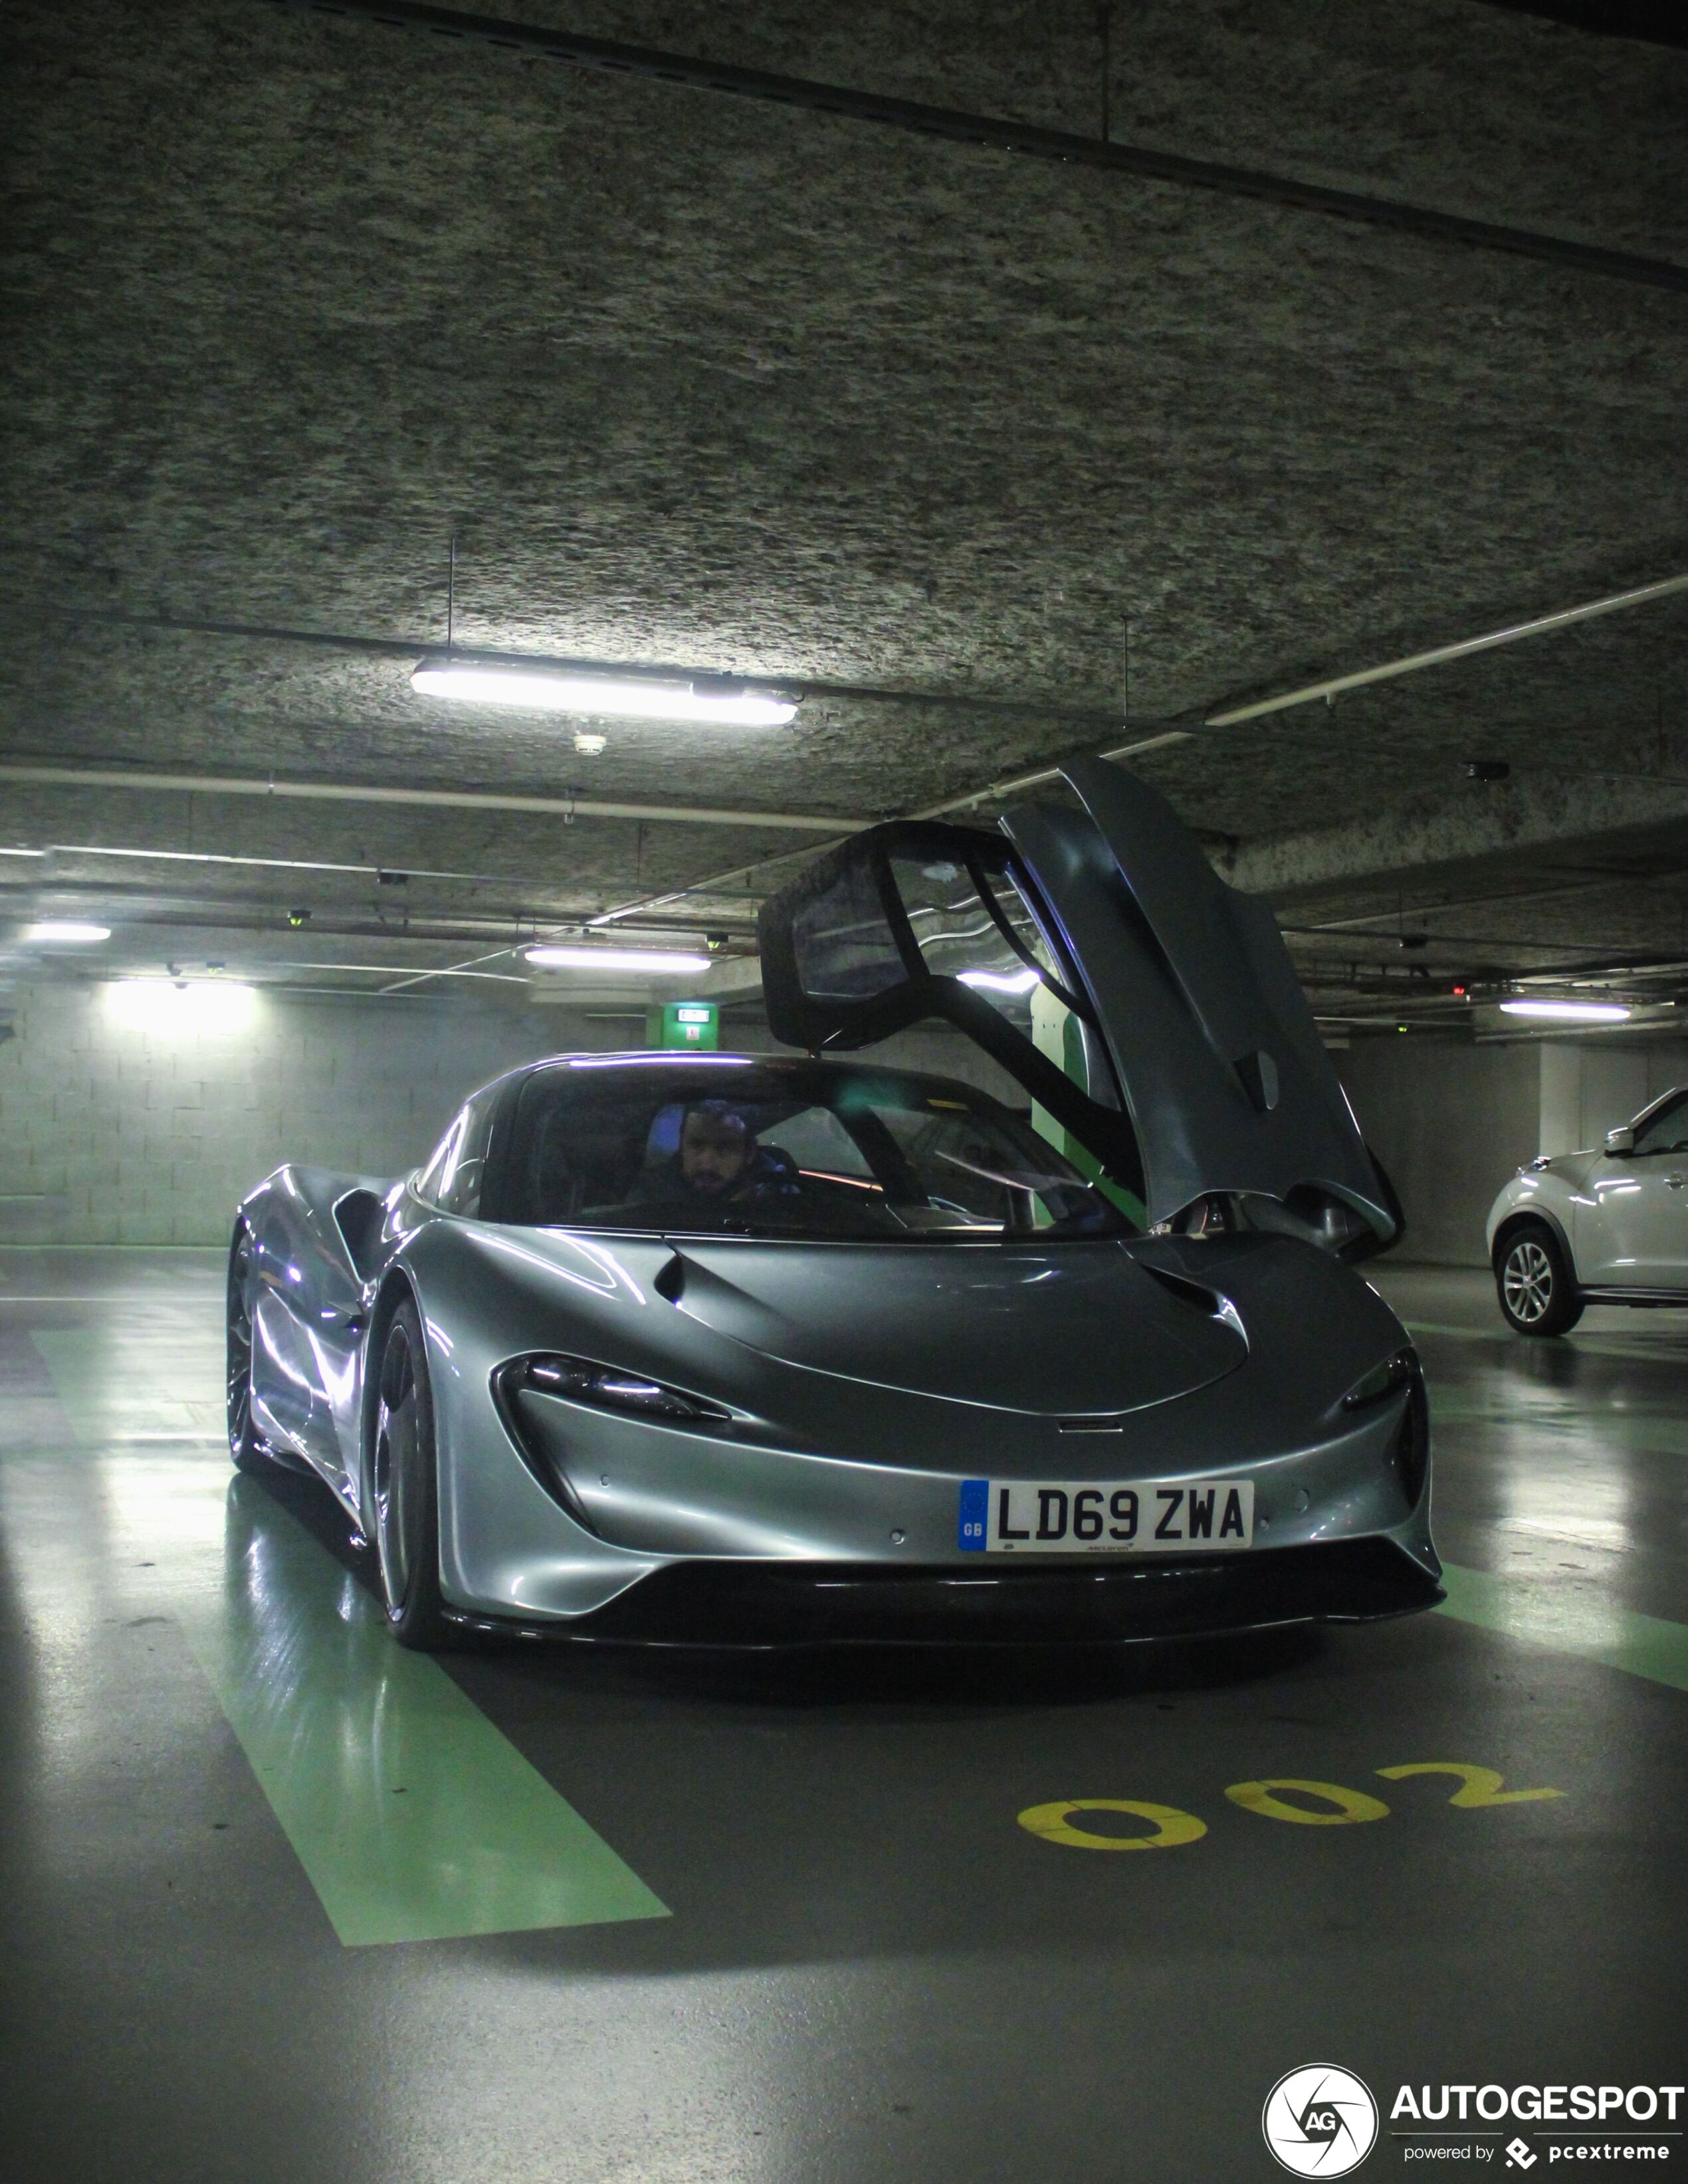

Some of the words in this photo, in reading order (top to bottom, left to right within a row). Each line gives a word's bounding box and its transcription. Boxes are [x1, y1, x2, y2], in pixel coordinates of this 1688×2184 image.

[964, 1523, 983, 1537] GB
[998, 1488, 1139, 1541] LD69
[1154, 1488, 1245, 1540] ZWA
